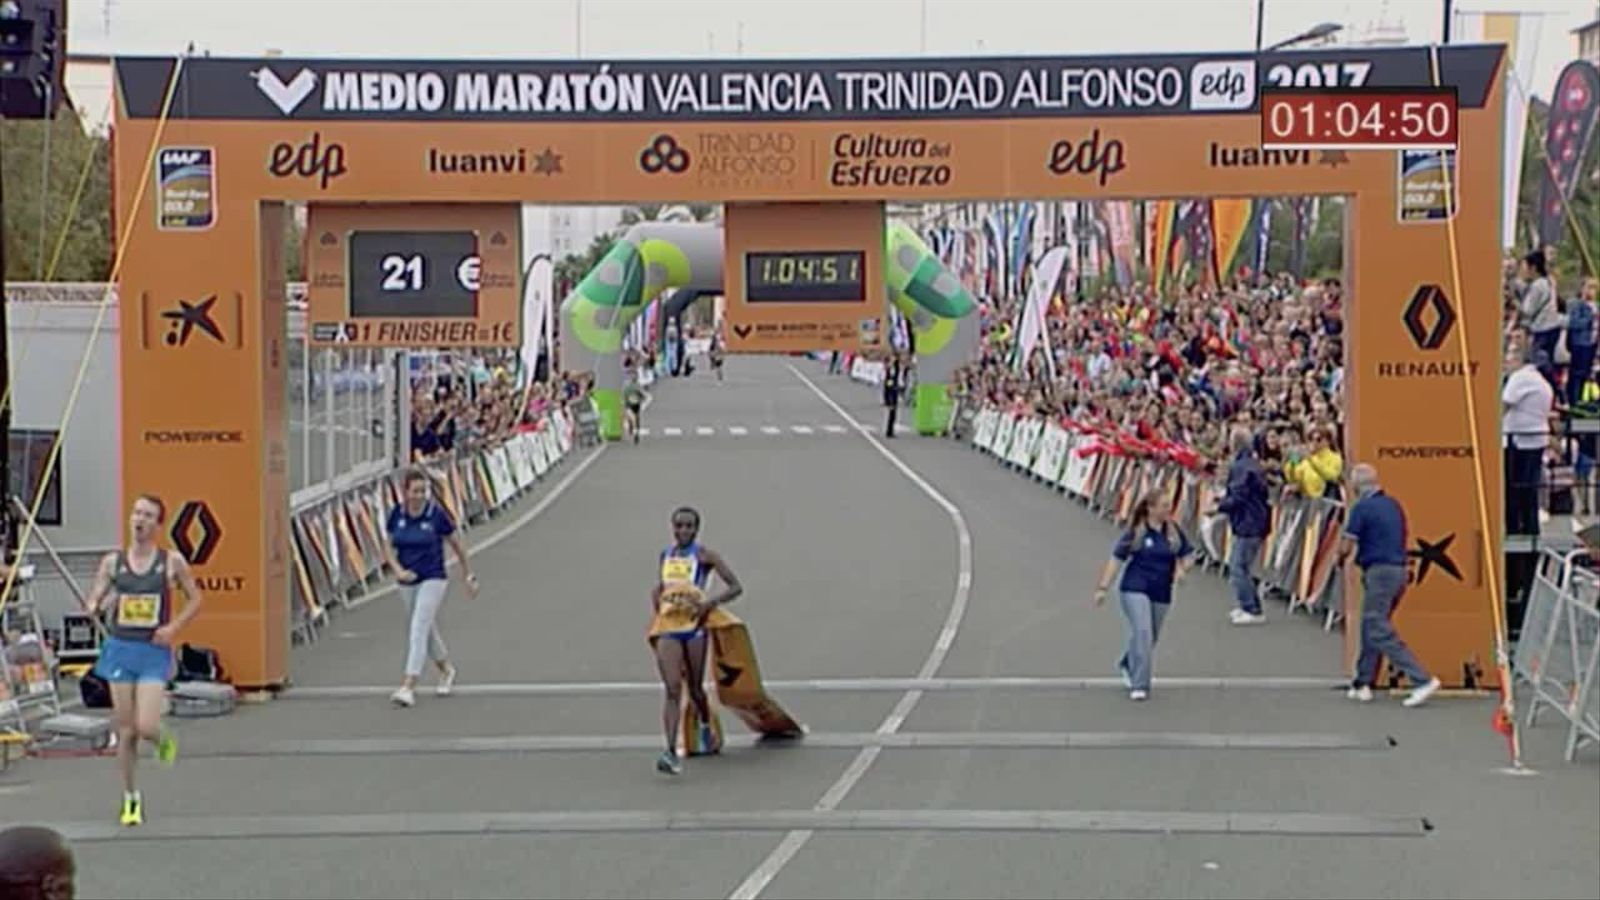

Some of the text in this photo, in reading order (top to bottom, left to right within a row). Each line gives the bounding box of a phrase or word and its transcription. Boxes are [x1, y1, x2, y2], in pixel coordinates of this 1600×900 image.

[323, 71, 447, 112] MEDIO
[453, 64, 645, 113] MARATÓN
[650, 70, 831, 112] VALENCIA
[836, 69, 1004, 110] TRINIDAD
[1011, 67, 1183, 108] ALFONSO
[1199, 67, 1245, 102] edp
[700, 132, 795, 151] TRINIDAD
[833, 133, 928, 158] Cultura
[268, 132, 348, 190] edp
[428, 147, 526, 174] luanvi
[699, 155, 796, 176] ALFONSO
[1047, 128, 1127, 187] edp
[830, 160, 952, 187] Esfuerzo
[381, 254, 425, 291] 21
[457, 255, 481, 291] €
[1378, 361, 1480, 376] RENAULT
